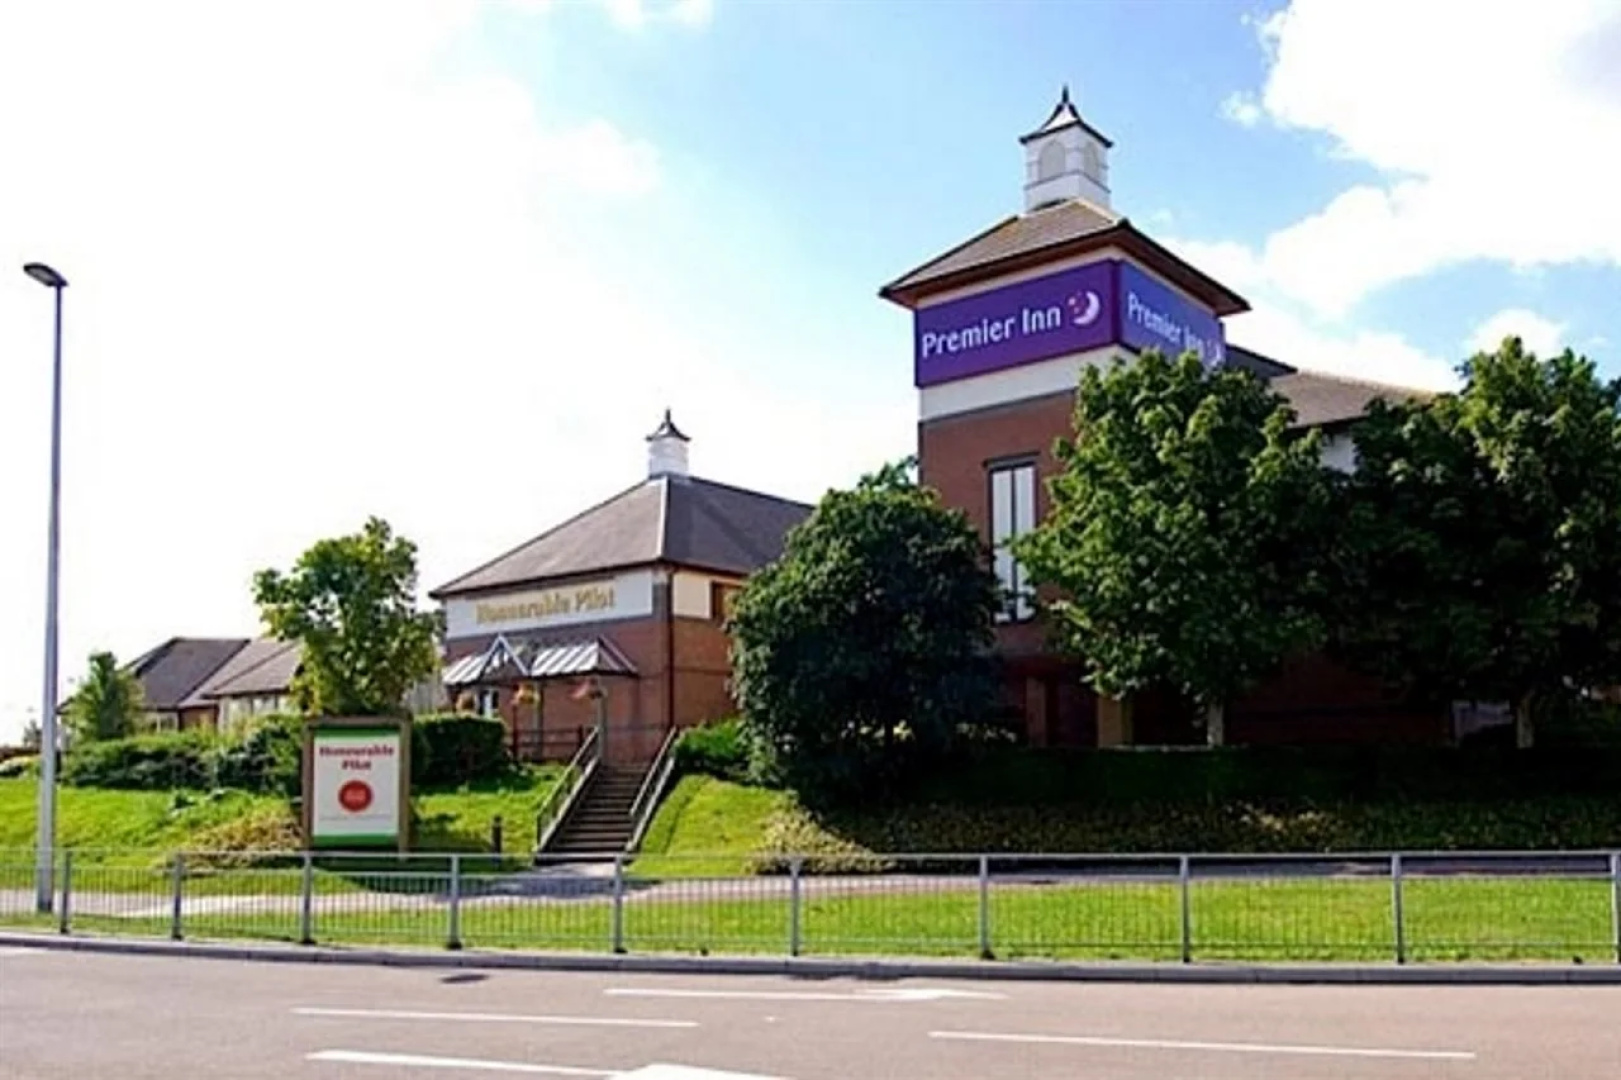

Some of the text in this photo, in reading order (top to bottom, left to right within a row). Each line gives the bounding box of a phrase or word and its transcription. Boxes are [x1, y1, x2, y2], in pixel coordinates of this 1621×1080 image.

[922, 306, 1061, 358] Premier Inn
[1128, 291, 1181, 343] Premier
